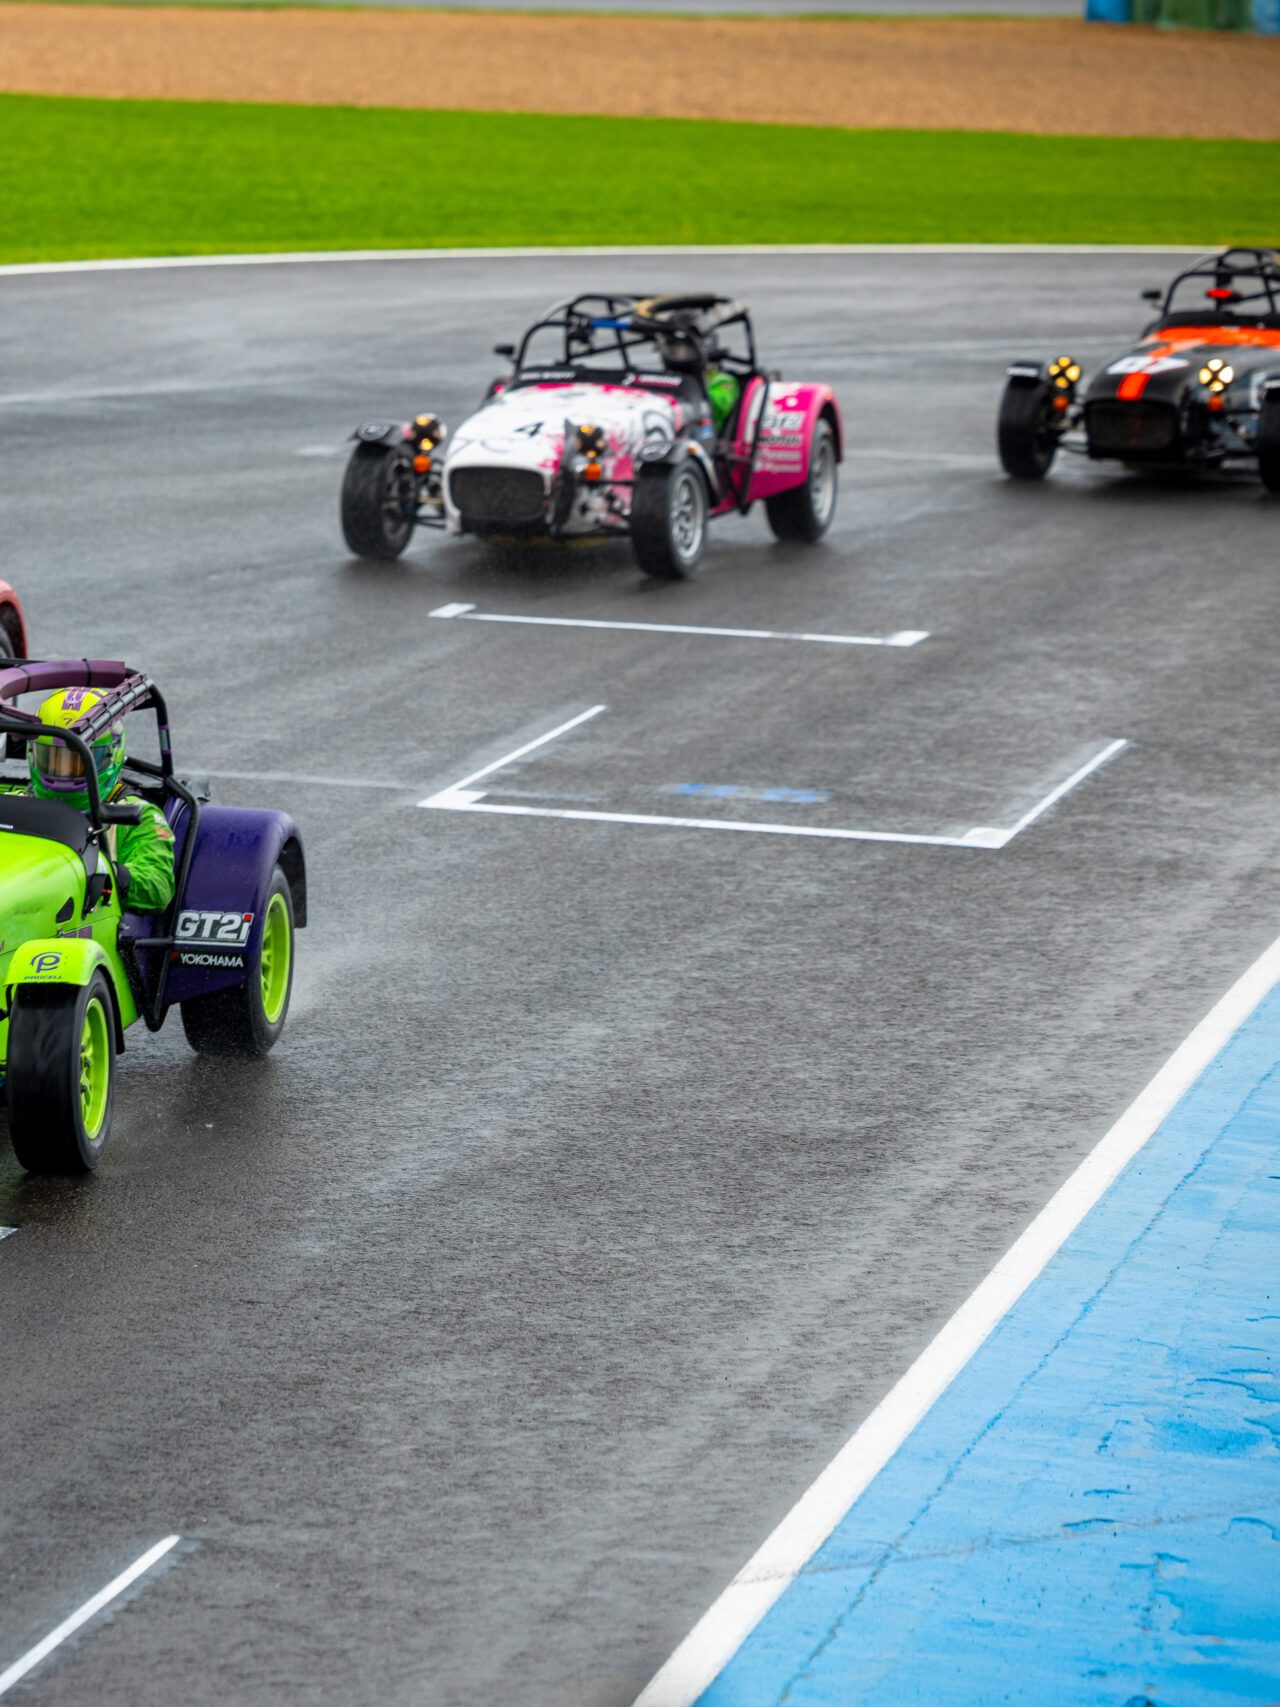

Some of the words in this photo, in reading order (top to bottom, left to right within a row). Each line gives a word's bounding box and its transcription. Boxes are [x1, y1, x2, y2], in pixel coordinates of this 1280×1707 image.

[513, 421, 544, 438] 4
[175, 911, 254, 940] GT2i
[180, 953, 244, 968] YOKOHAMA
